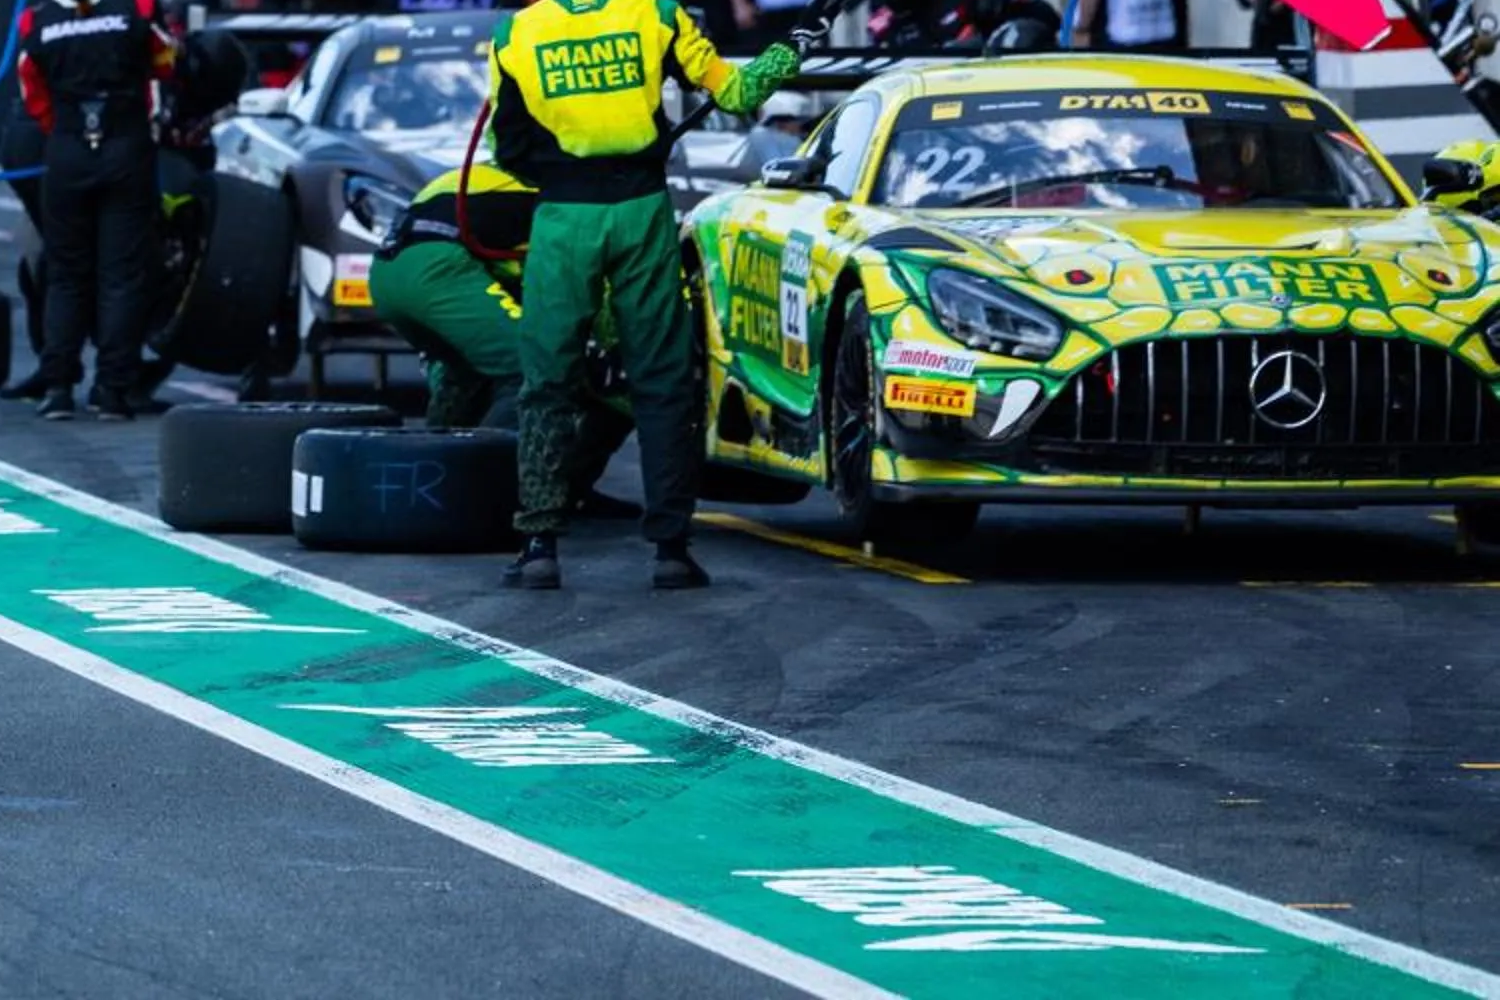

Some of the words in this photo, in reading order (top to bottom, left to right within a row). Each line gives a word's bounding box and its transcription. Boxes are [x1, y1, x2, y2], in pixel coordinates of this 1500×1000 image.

[542, 37, 639, 69] MANN
[546, 61, 641, 93] FILTER
[1157, 95, 1200, 110] 40
[915, 146, 987, 192] 22
[733, 243, 781, 304] MANN
[1166, 261, 1367, 281] MANN
[1173, 278, 1378, 301] FILTER
[786, 288, 800, 335] 22
[891, 383, 966, 409] PIRELLI
[366, 460, 447, 513] FR
